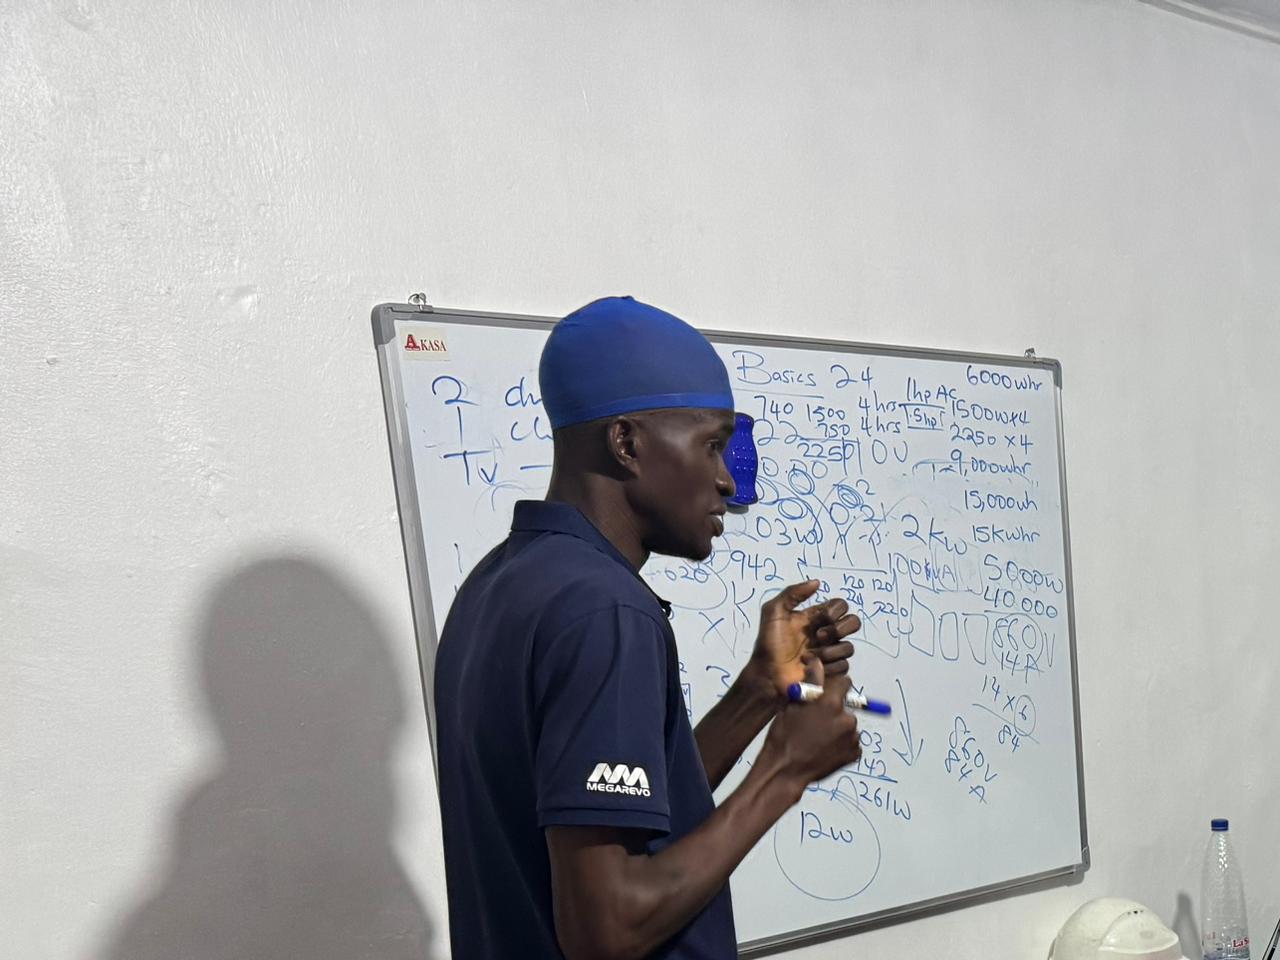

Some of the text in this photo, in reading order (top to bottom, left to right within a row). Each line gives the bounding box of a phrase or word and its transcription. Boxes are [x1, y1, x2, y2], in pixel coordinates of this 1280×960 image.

[404, 333, 448, 352] AKASA
[732, 350, 817, 387] Basics
[935, 384, 958, 404] AC
[806, 402, 846, 423] 1500
[730, 550, 785, 581] 942
[586, 782, 651, 797] MEGAREVO
